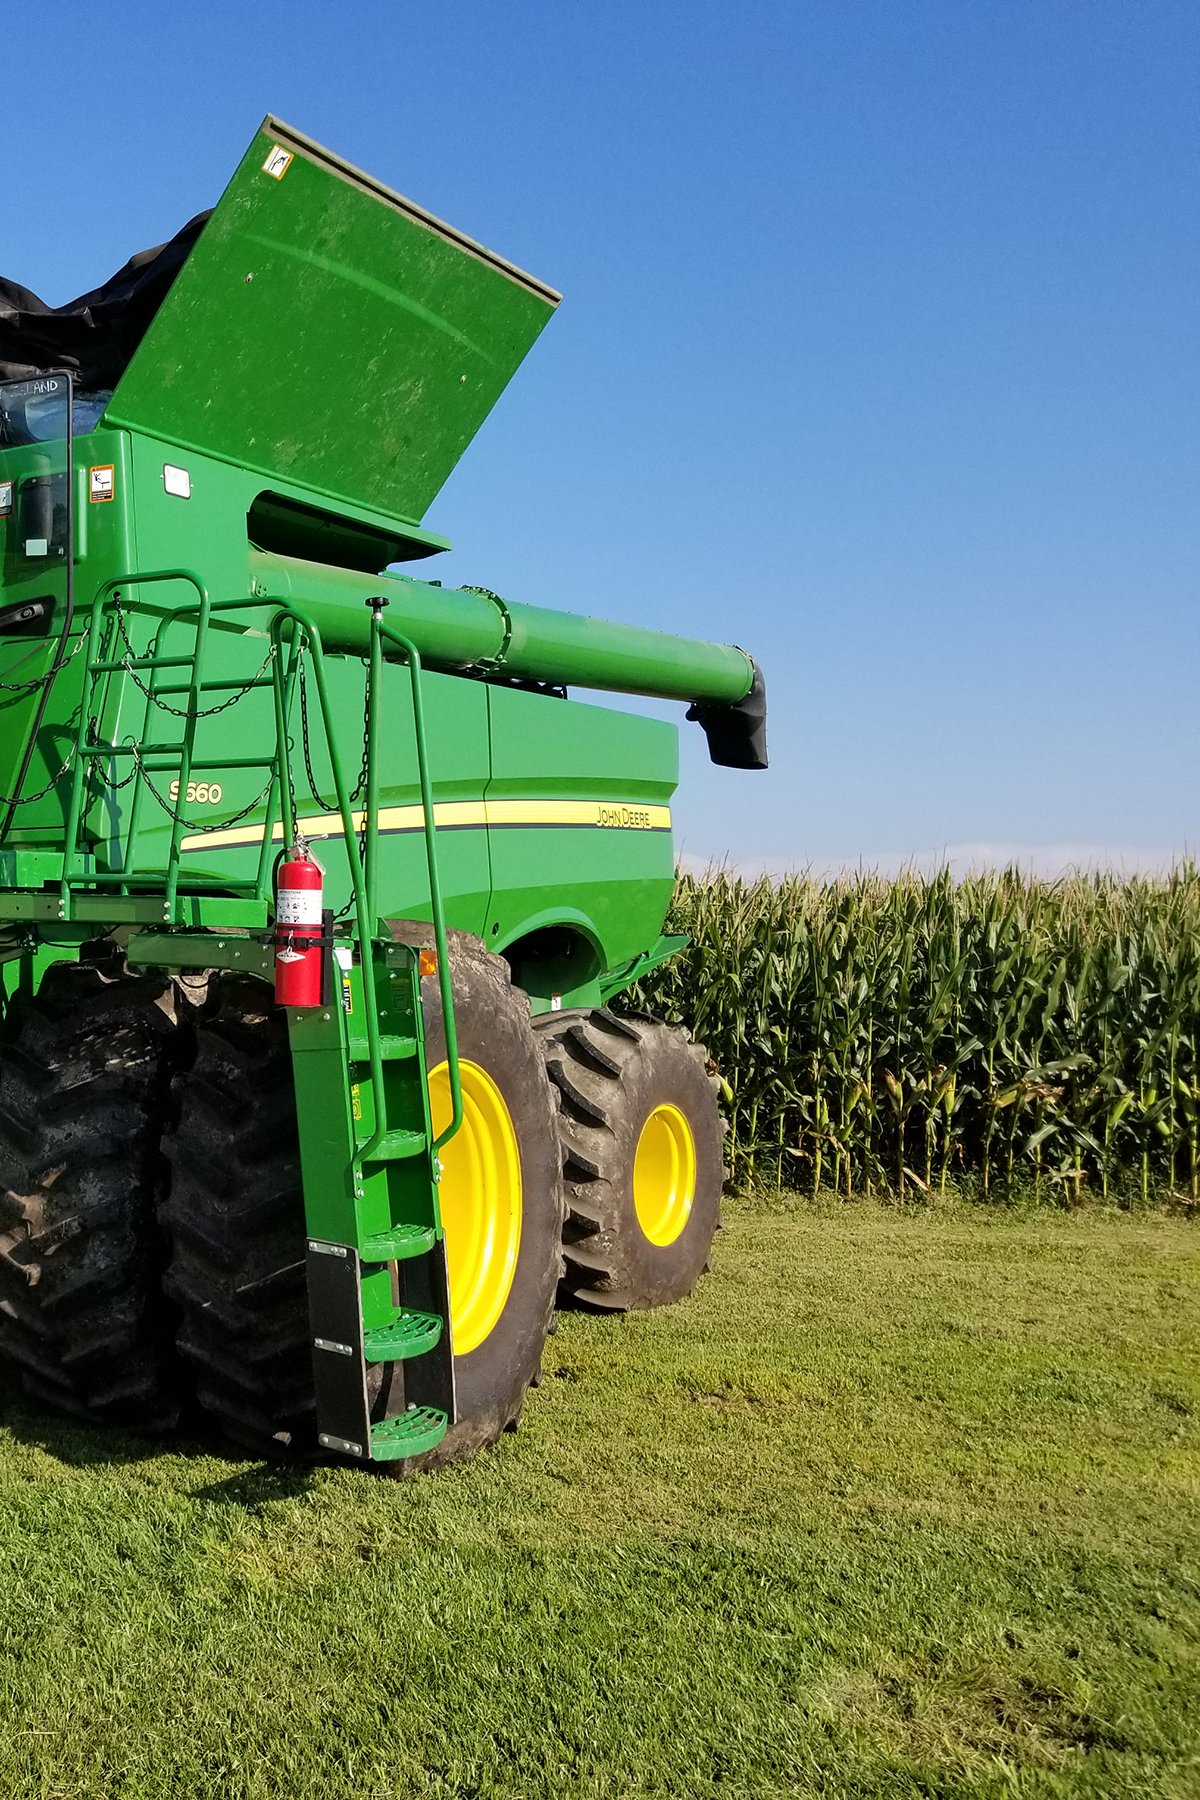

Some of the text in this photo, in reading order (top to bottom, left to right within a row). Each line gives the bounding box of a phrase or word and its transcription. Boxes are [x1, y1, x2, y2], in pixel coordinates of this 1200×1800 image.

[169, 779, 223, 805] S660
[596, 806, 651, 827] JOHN DEERE
